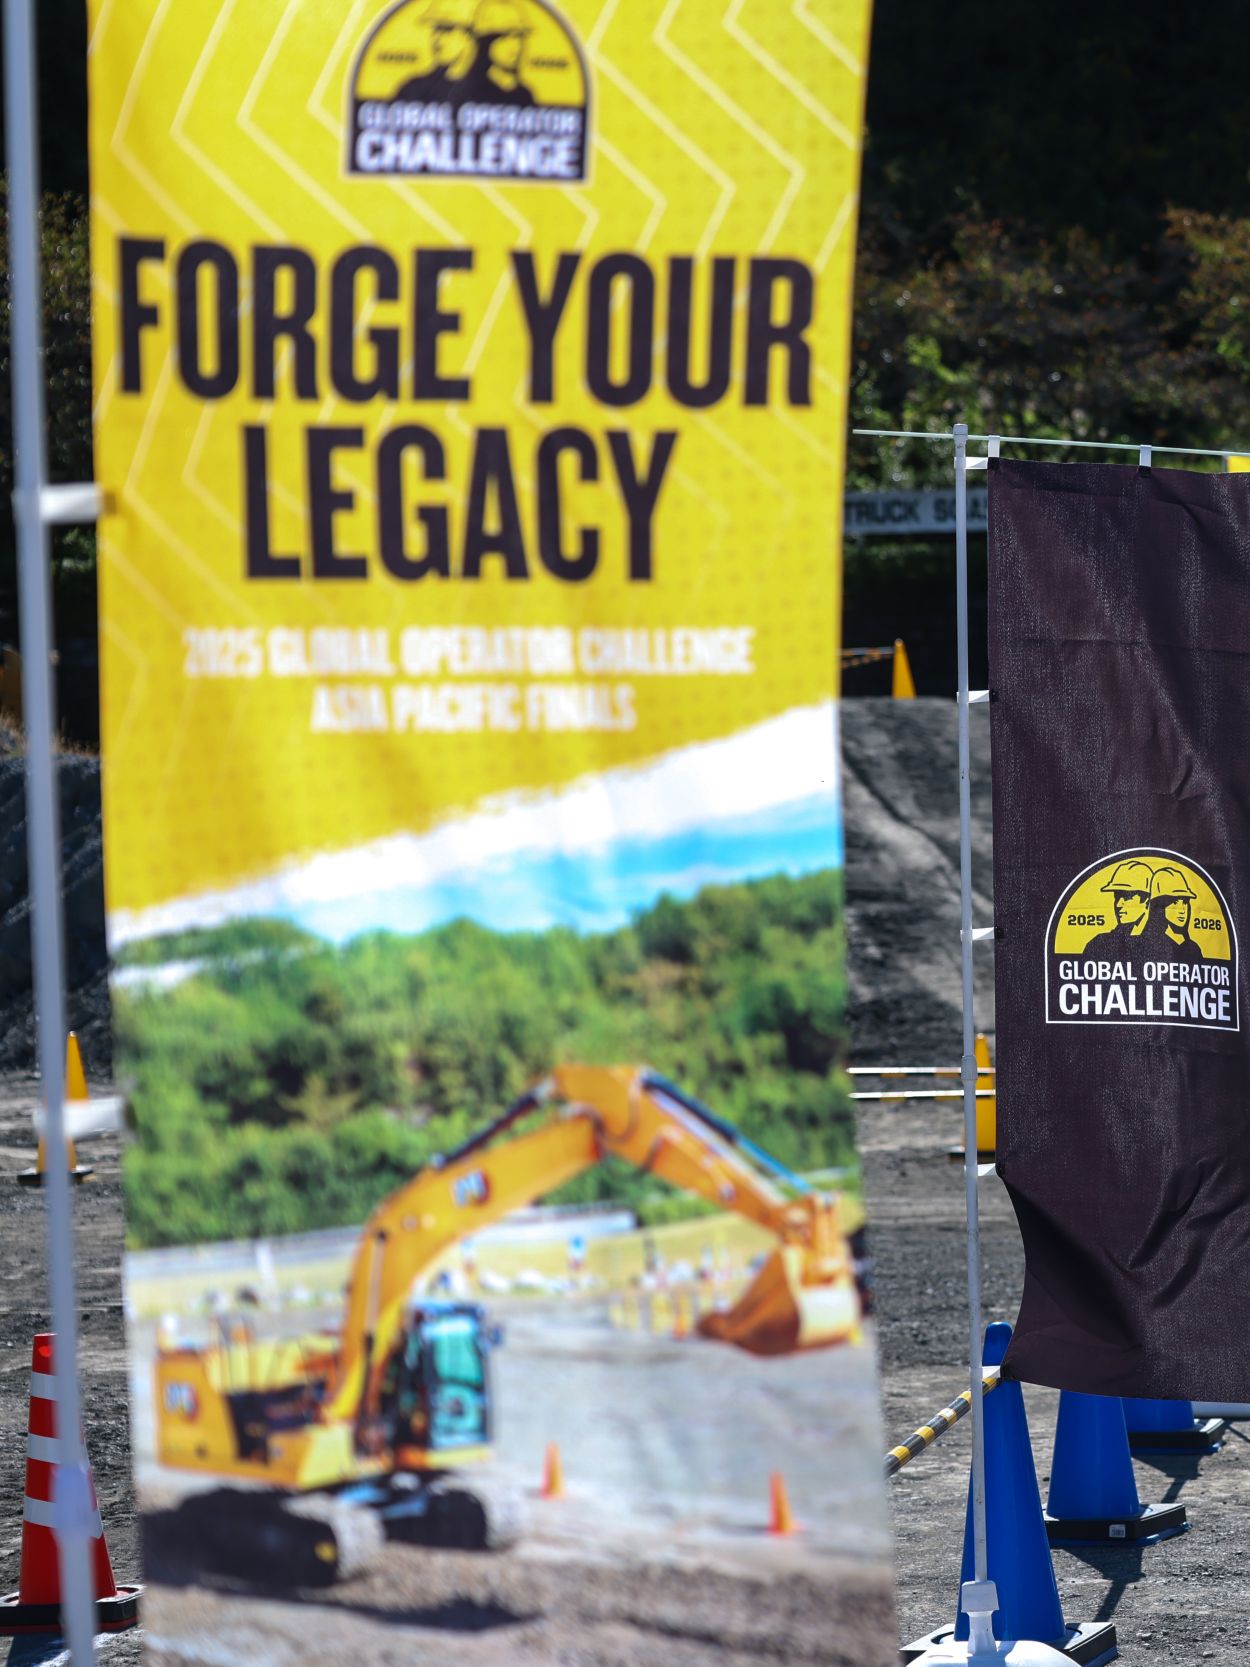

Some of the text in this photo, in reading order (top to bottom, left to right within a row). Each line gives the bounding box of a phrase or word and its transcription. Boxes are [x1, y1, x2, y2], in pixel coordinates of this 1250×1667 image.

[356, 130, 581, 178] CHALLENGE
[115, 233, 816, 408] FORGE YOUR
[242, 423, 679, 582] LEGACY
[580, 625, 755, 674] CHALLENGE
[1067, 914, 1105, 926] 2025
[1193, 918, 1222, 930] 2026
[1059, 960, 1230, 986] GLOBAL OPERATOR
[1058, 983, 1231, 1021] CHALLENGE
